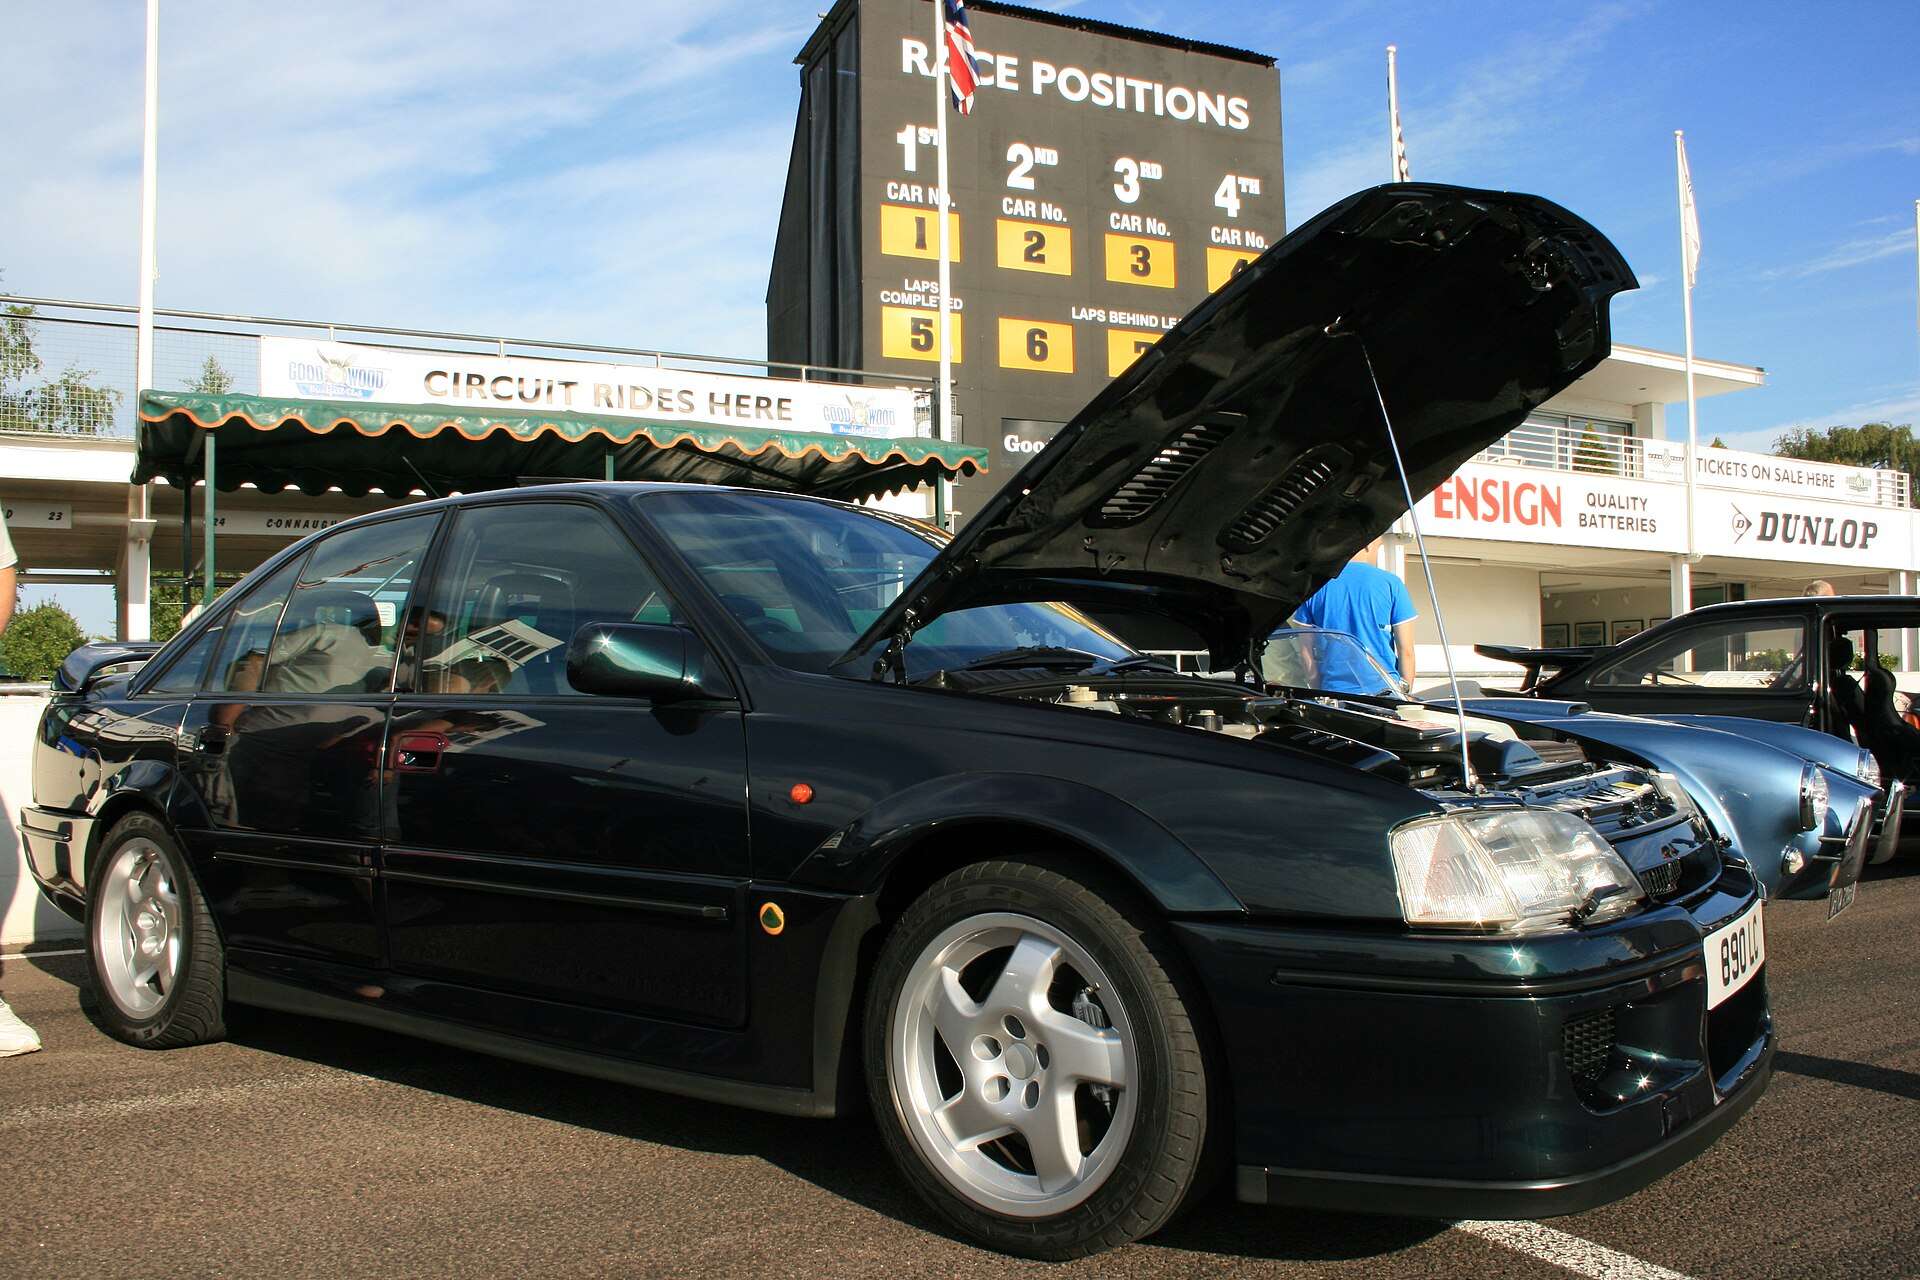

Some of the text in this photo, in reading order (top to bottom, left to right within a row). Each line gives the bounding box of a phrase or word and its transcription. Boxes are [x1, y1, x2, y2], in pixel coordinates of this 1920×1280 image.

[1032, 61, 1249, 130] POSITIONS
[1007, 143, 1058, 190] 2ND
[1114, 157, 1162, 203] 3RD
[887, 182, 923, 203] CAR
[1215, 174, 1260, 217] 4TH
[1002, 197, 1067, 222] CAR No.
[1110, 212, 1170, 236] CAR No.
[915, 216, 927, 250] 1
[1024, 230, 1046, 264] 2
[1211, 226, 1268, 249] CAR No.
[1130, 245, 1151, 277] 3
[880, 290, 963, 310] COMPLEED
[905, 279, 939, 294] LAPS
[1072, 307, 1182, 329] LAPS BEHIND LE
[911, 317, 934, 352] 5
[1026, 328, 1049, 362] 6
[424, 370, 793, 421] CIRCUIT RIDES HERE
[1696, 457, 1748, 478] TICKETS
[1751, 464, 1771, 481] ON
[1774, 468, 1803, 485] SALE
[1806, 472, 1835, 489] HERE
[48, 511, 63, 521] 23
[1434, 475, 1562, 528] ENSIGN
[1586, 492, 1648, 513] QUALITY
[1578, 512, 1657, 534] BATTERIES
[1757, 511, 1879, 550] DUNLOP
